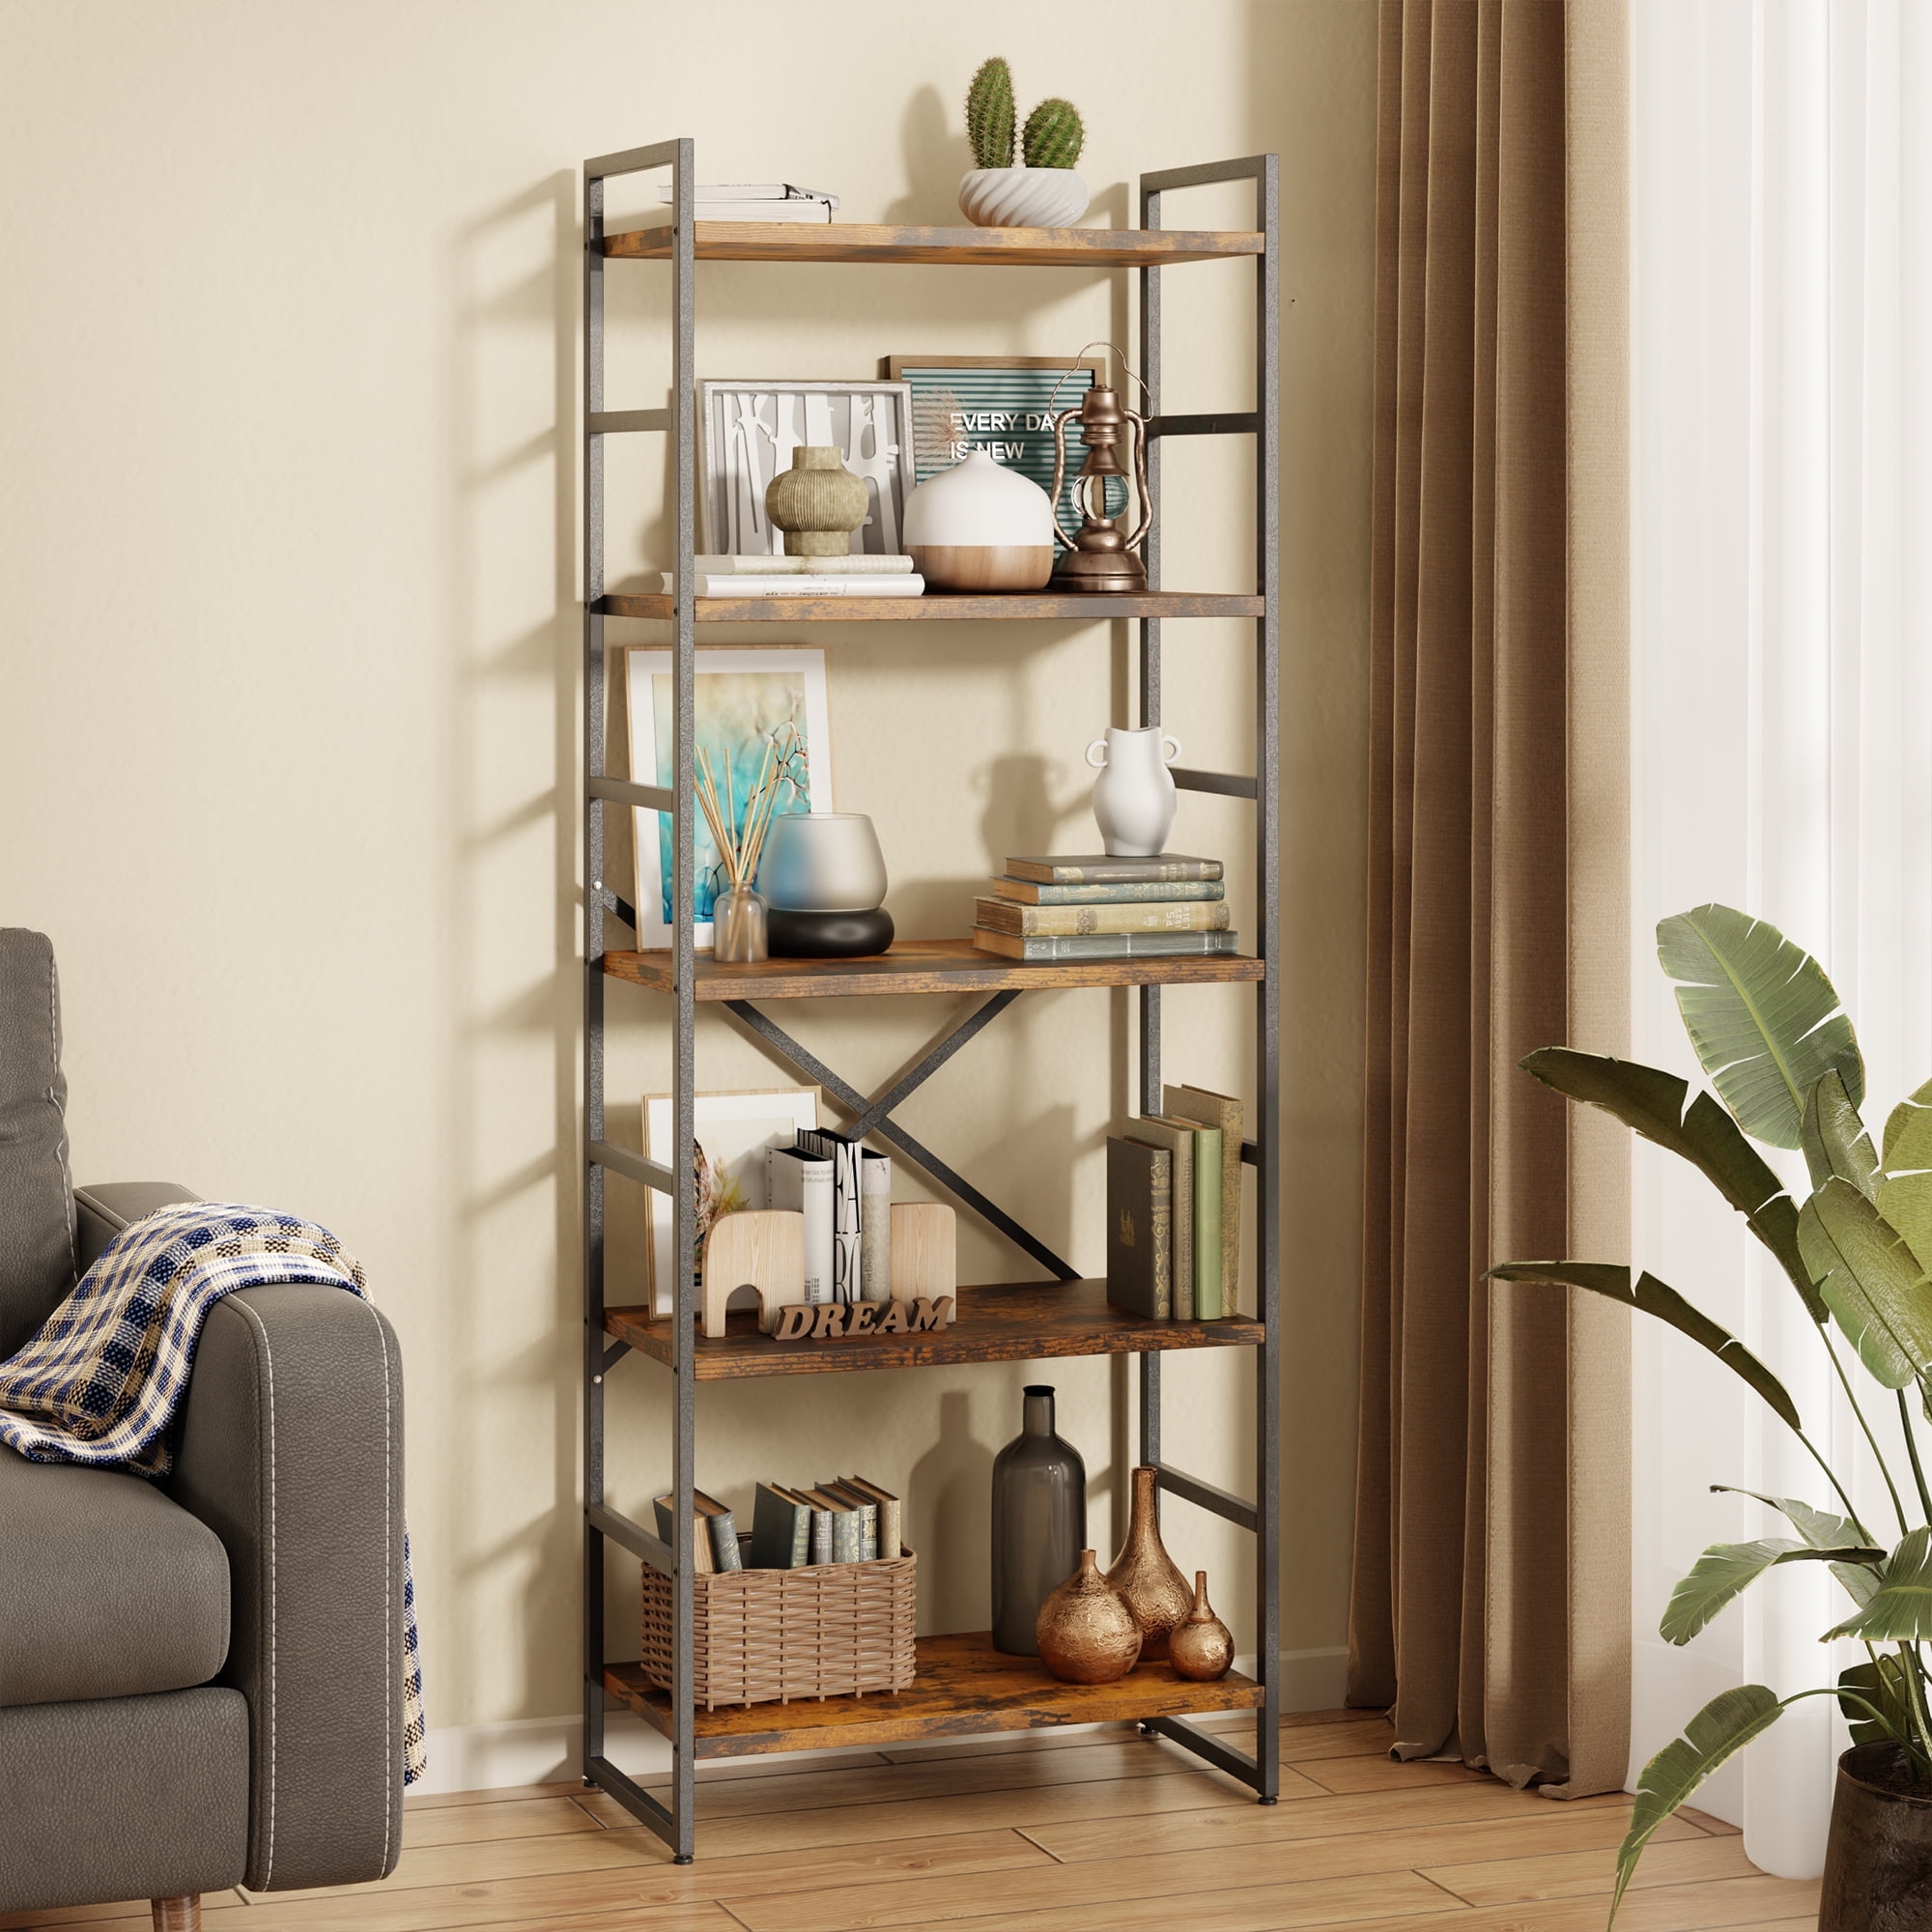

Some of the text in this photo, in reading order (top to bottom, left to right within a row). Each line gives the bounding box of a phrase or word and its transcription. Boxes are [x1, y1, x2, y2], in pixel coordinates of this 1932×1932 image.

[951, 412, 1059, 431] EVERY DA
[951, 441, 969, 459] IS
[775, 1295, 954, 1341] DREAM
